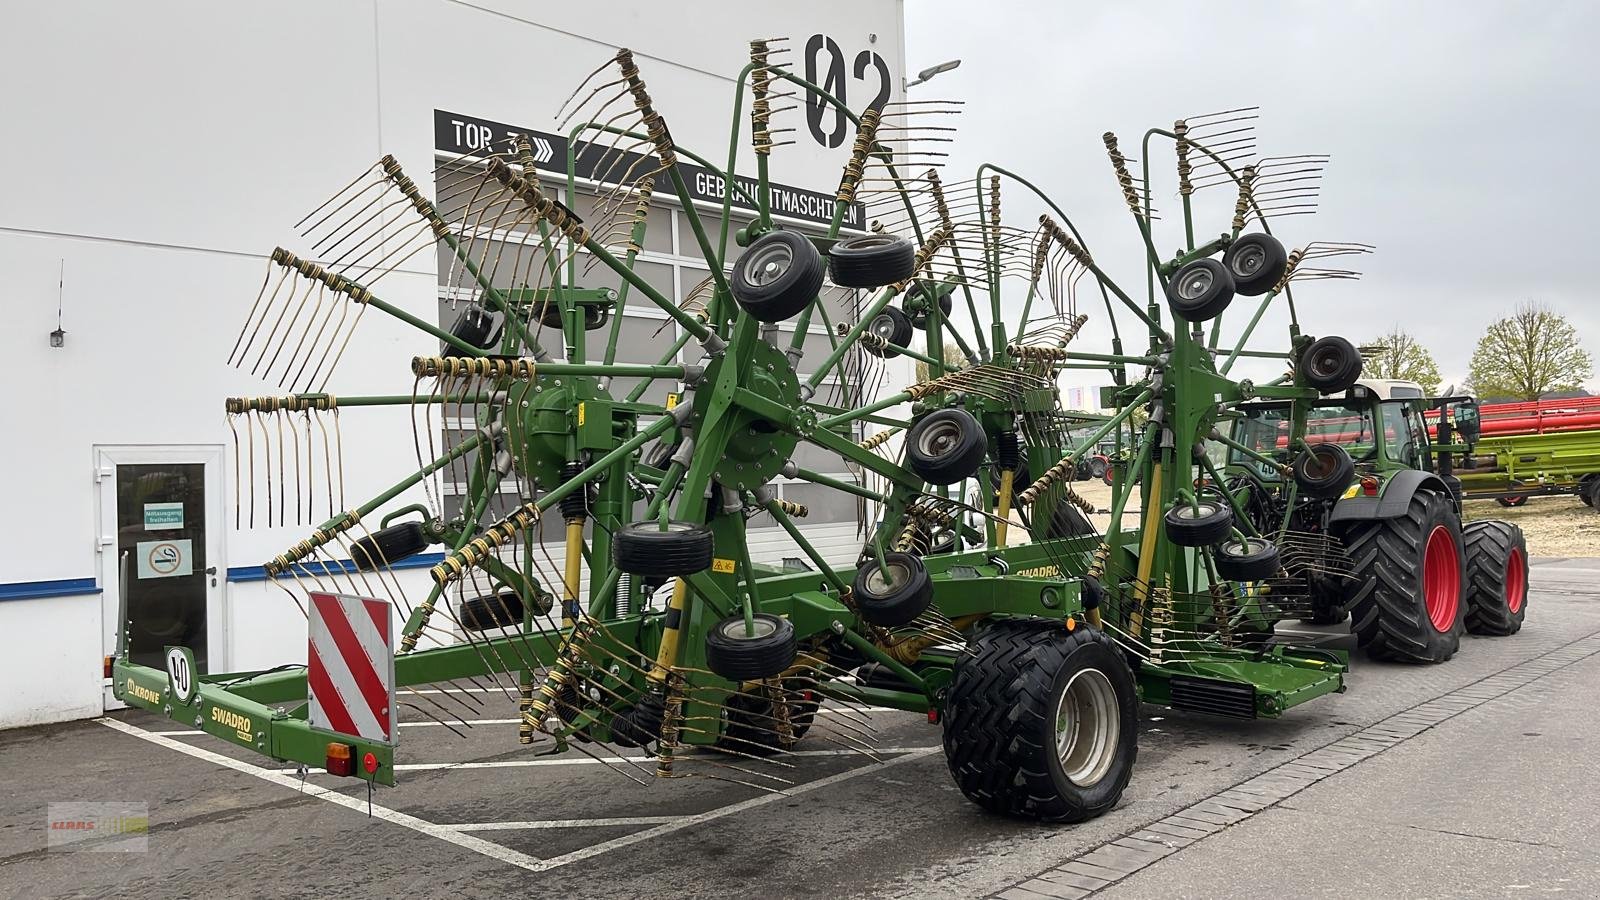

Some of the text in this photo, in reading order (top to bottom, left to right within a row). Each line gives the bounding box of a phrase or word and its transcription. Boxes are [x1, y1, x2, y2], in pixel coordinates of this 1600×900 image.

[804, 33, 893, 158] 02
[451, 119, 522, 155] TOR 3
[696, 172, 858, 225] GEBAUCTMASCHIN
[171, 656, 188, 692] 40
[135, 685, 160, 704] KRONE
[211, 706, 251, 733] SWADRO
